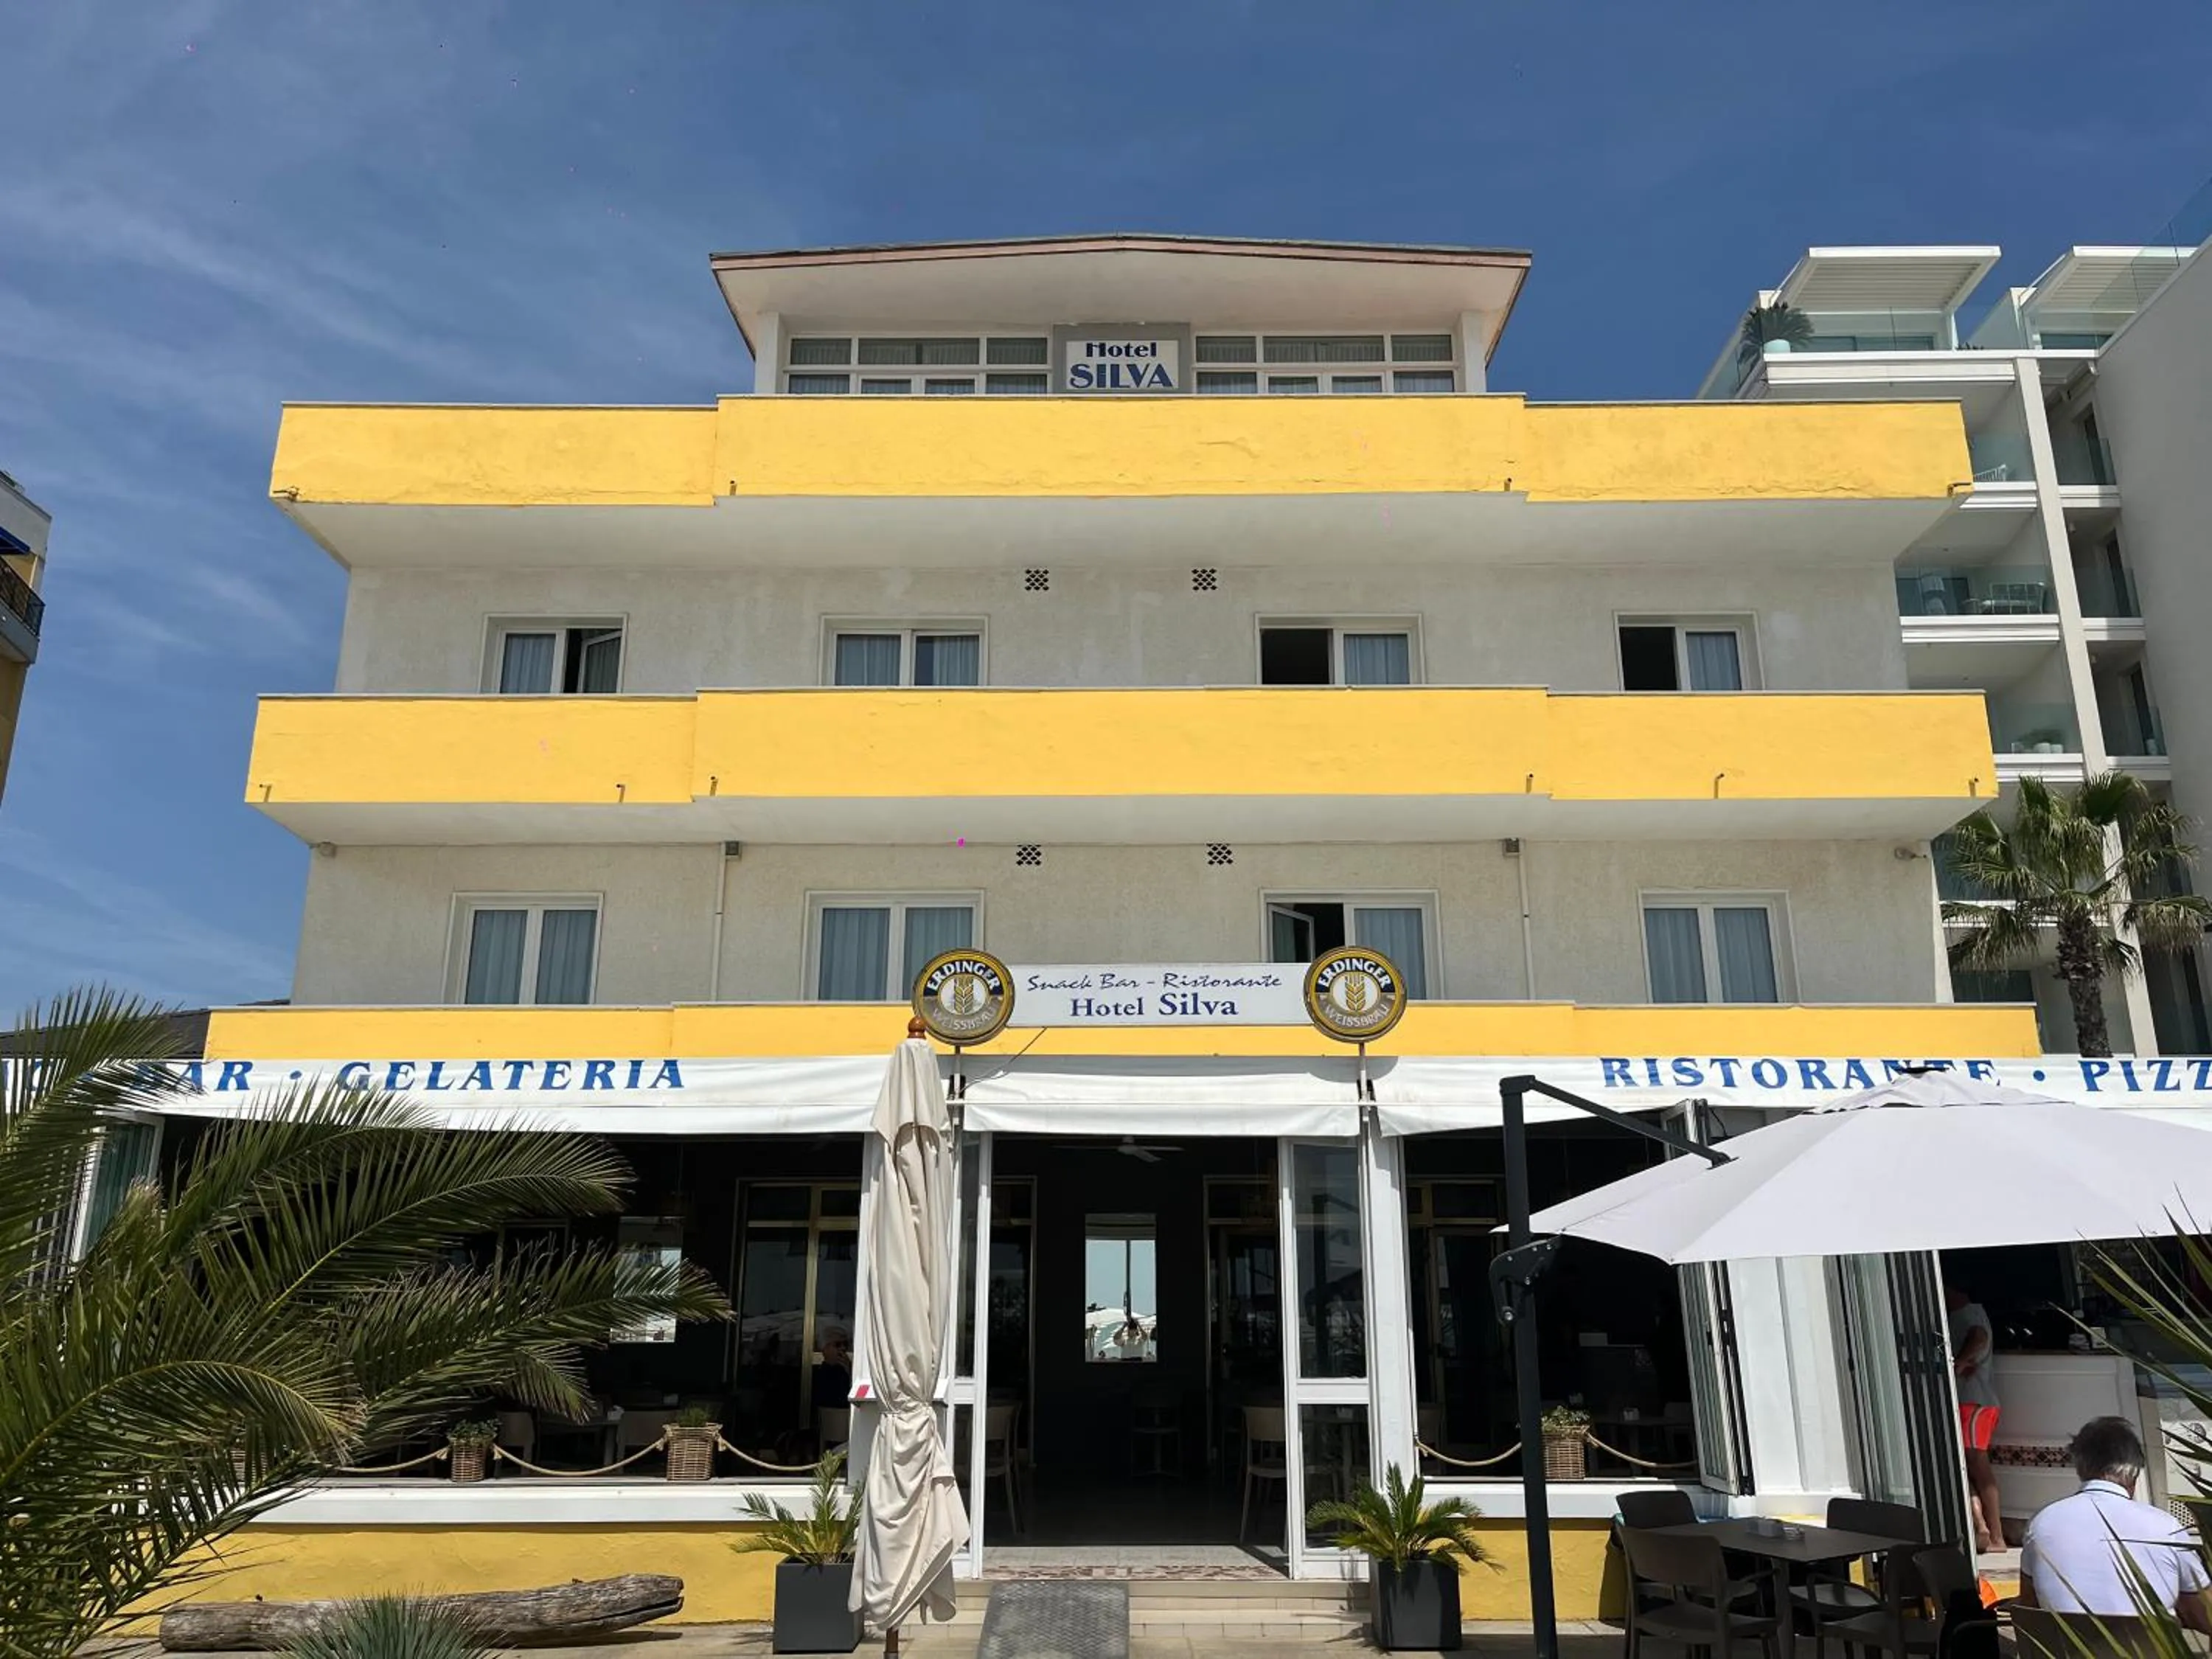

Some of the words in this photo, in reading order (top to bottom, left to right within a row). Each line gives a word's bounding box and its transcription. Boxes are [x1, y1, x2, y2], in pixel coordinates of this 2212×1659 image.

[1085, 341, 1158, 358] Hotel
[1069, 363, 1174, 388] SILVA
[926, 961, 1001, 991] ERDINGER
[1027, 974, 1093, 991] Snack
[1099, 973, 1141, 990] Bar
[1162, 972, 1282, 989] Ristorante
[1317, 958, 1392, 989] ERDINGER
[1070, 997, 1144, 1017] Hotel
[1158, 992, 1239, 1016] Silva
[337, 1060, 685, 1091] GELATERIA
[2078, 1060, 2212, 1091] PIZZ
